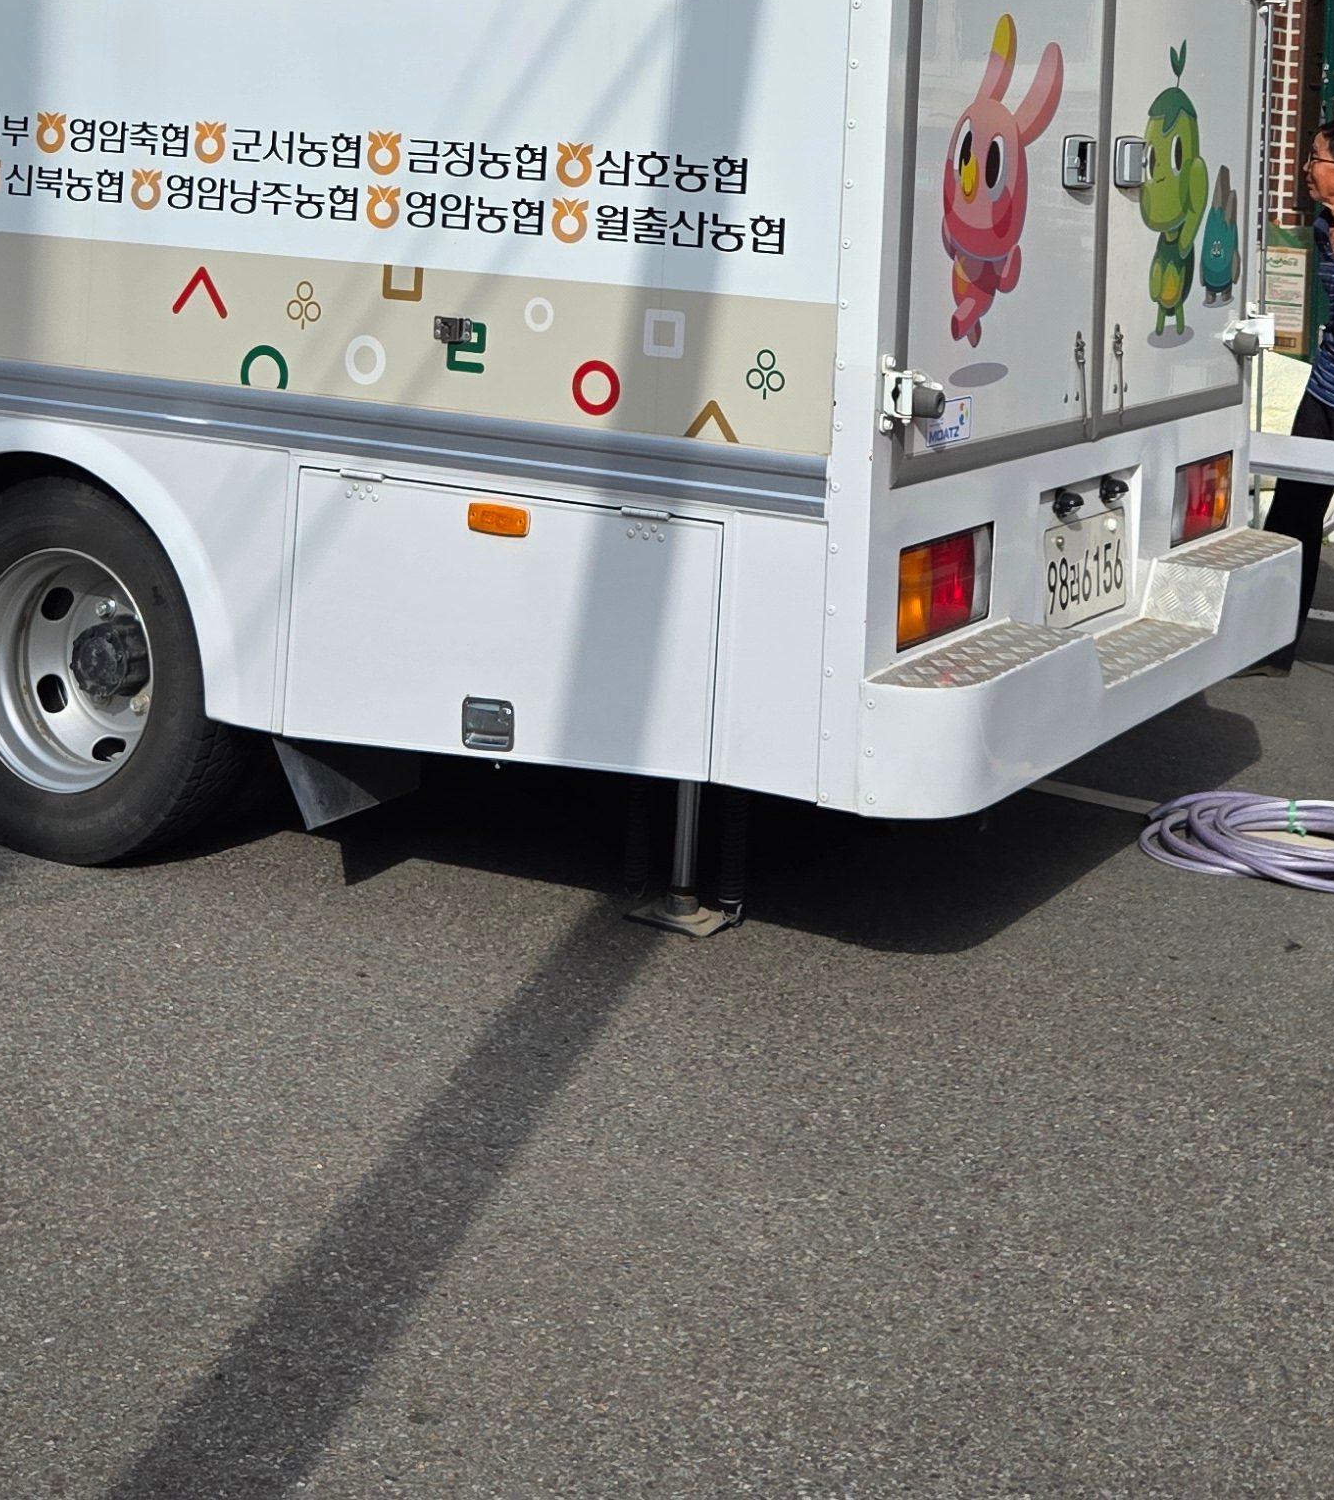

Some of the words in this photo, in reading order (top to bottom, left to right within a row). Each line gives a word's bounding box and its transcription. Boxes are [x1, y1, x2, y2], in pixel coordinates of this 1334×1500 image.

[69, 118, 189, 159] 영암축협
[232, 129, 360, 170] 군서농협
[408, 136, 547, 182] 금정농협
[596, 150, 748, 195] 삼호농협
[5, 163, 124, 204] 신북농협
[167, 173, 358, 222] 영암낭주농협
[407, 191, 544, 237] 영암농협
[596, 203, 786, 256] 월출산농협
